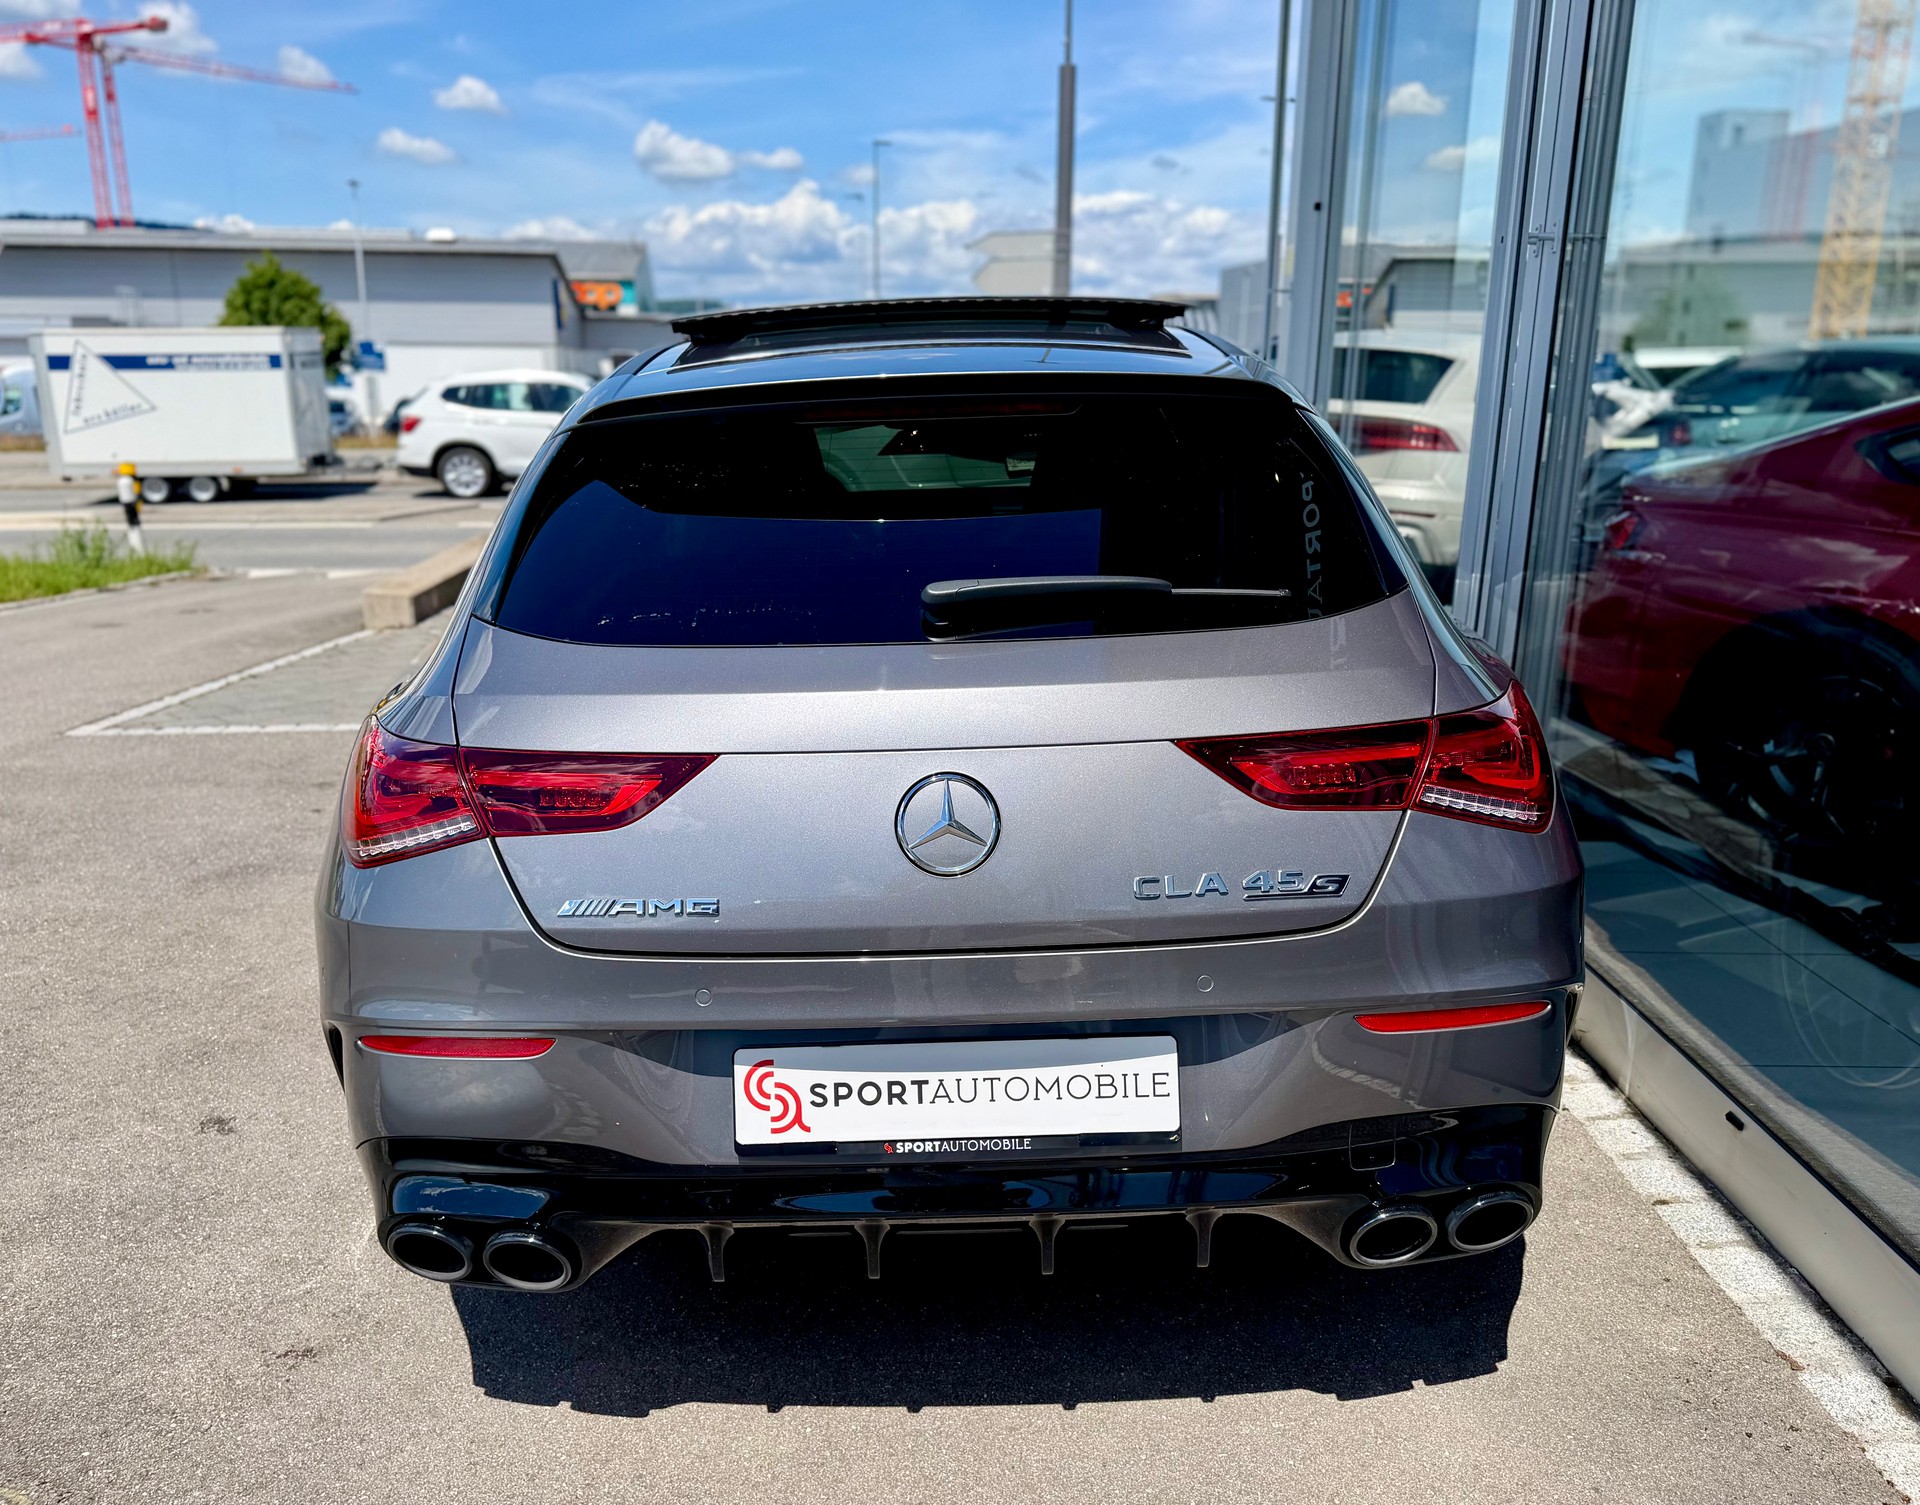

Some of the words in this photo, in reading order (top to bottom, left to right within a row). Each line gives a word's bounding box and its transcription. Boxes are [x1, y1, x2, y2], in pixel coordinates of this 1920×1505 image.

[1133, 872, 1229, 899] CLA
[809, 1072, 1171, 1108] SPORTAUTOMOBILE
[895, 1138, 1032, 1154] SPORTAUTOMOBILE
